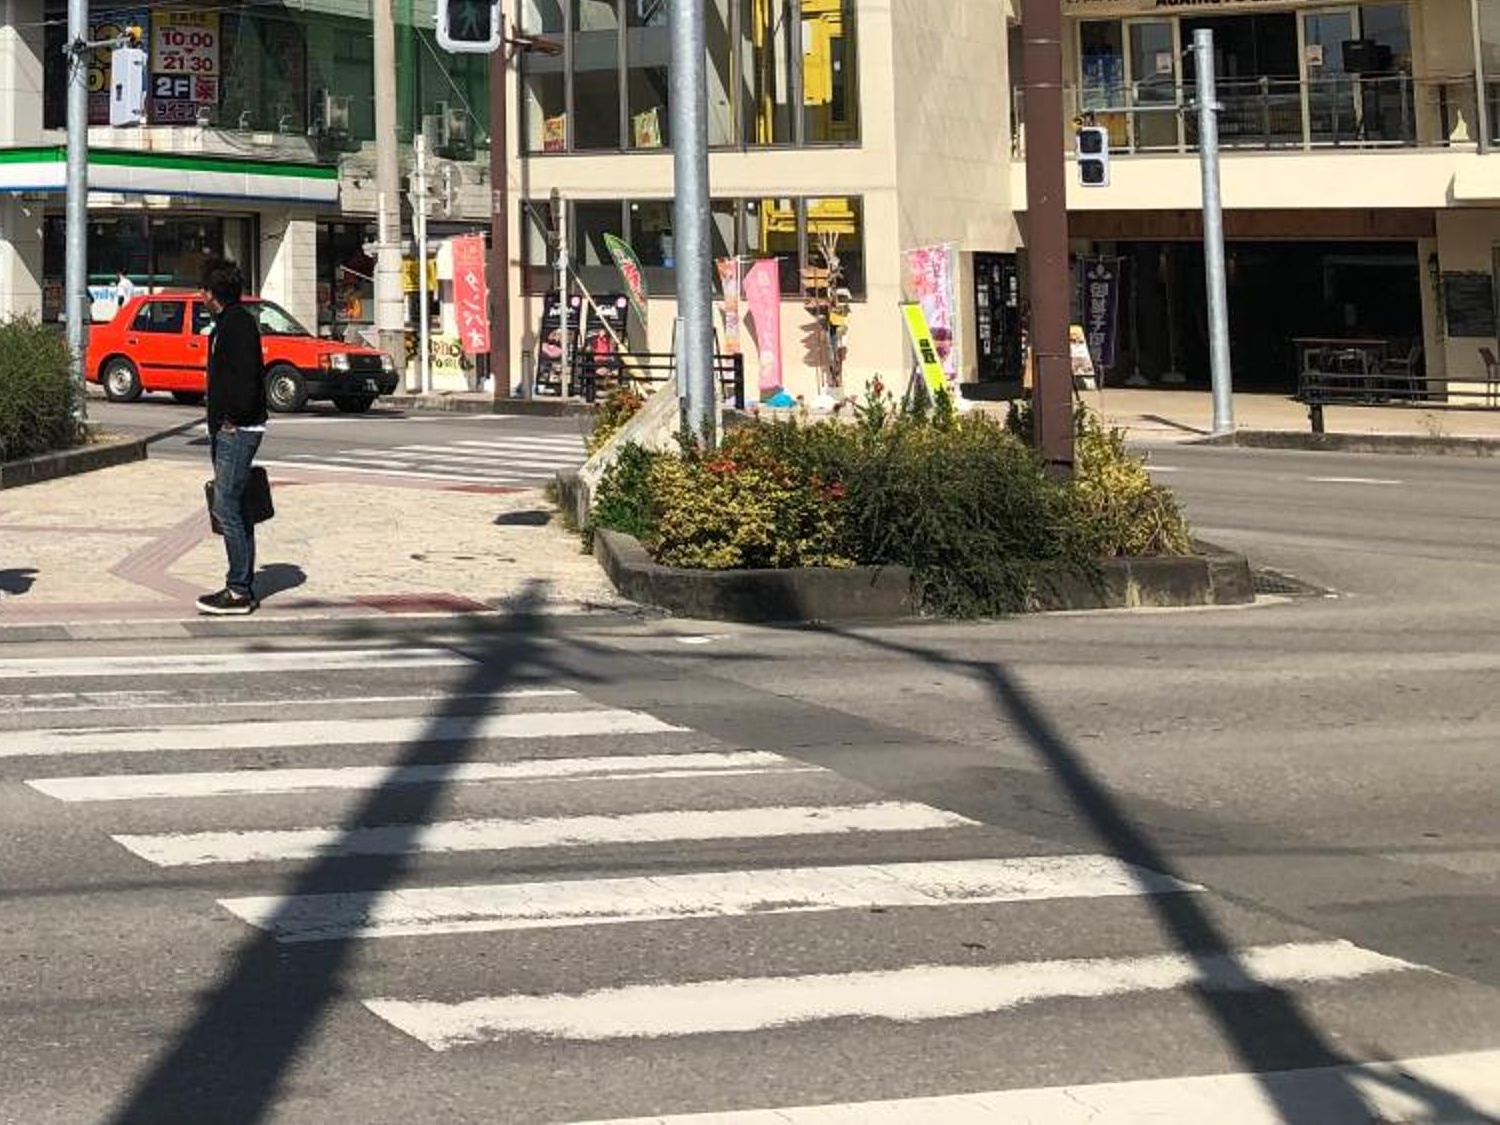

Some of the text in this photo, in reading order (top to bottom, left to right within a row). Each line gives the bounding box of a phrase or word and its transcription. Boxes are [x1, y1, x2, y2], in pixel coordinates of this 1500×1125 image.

[162, 31, 214, 48] 10:00
[163, 56, 214, 72] 21:30
[156, 77, 189, 97] 2F
